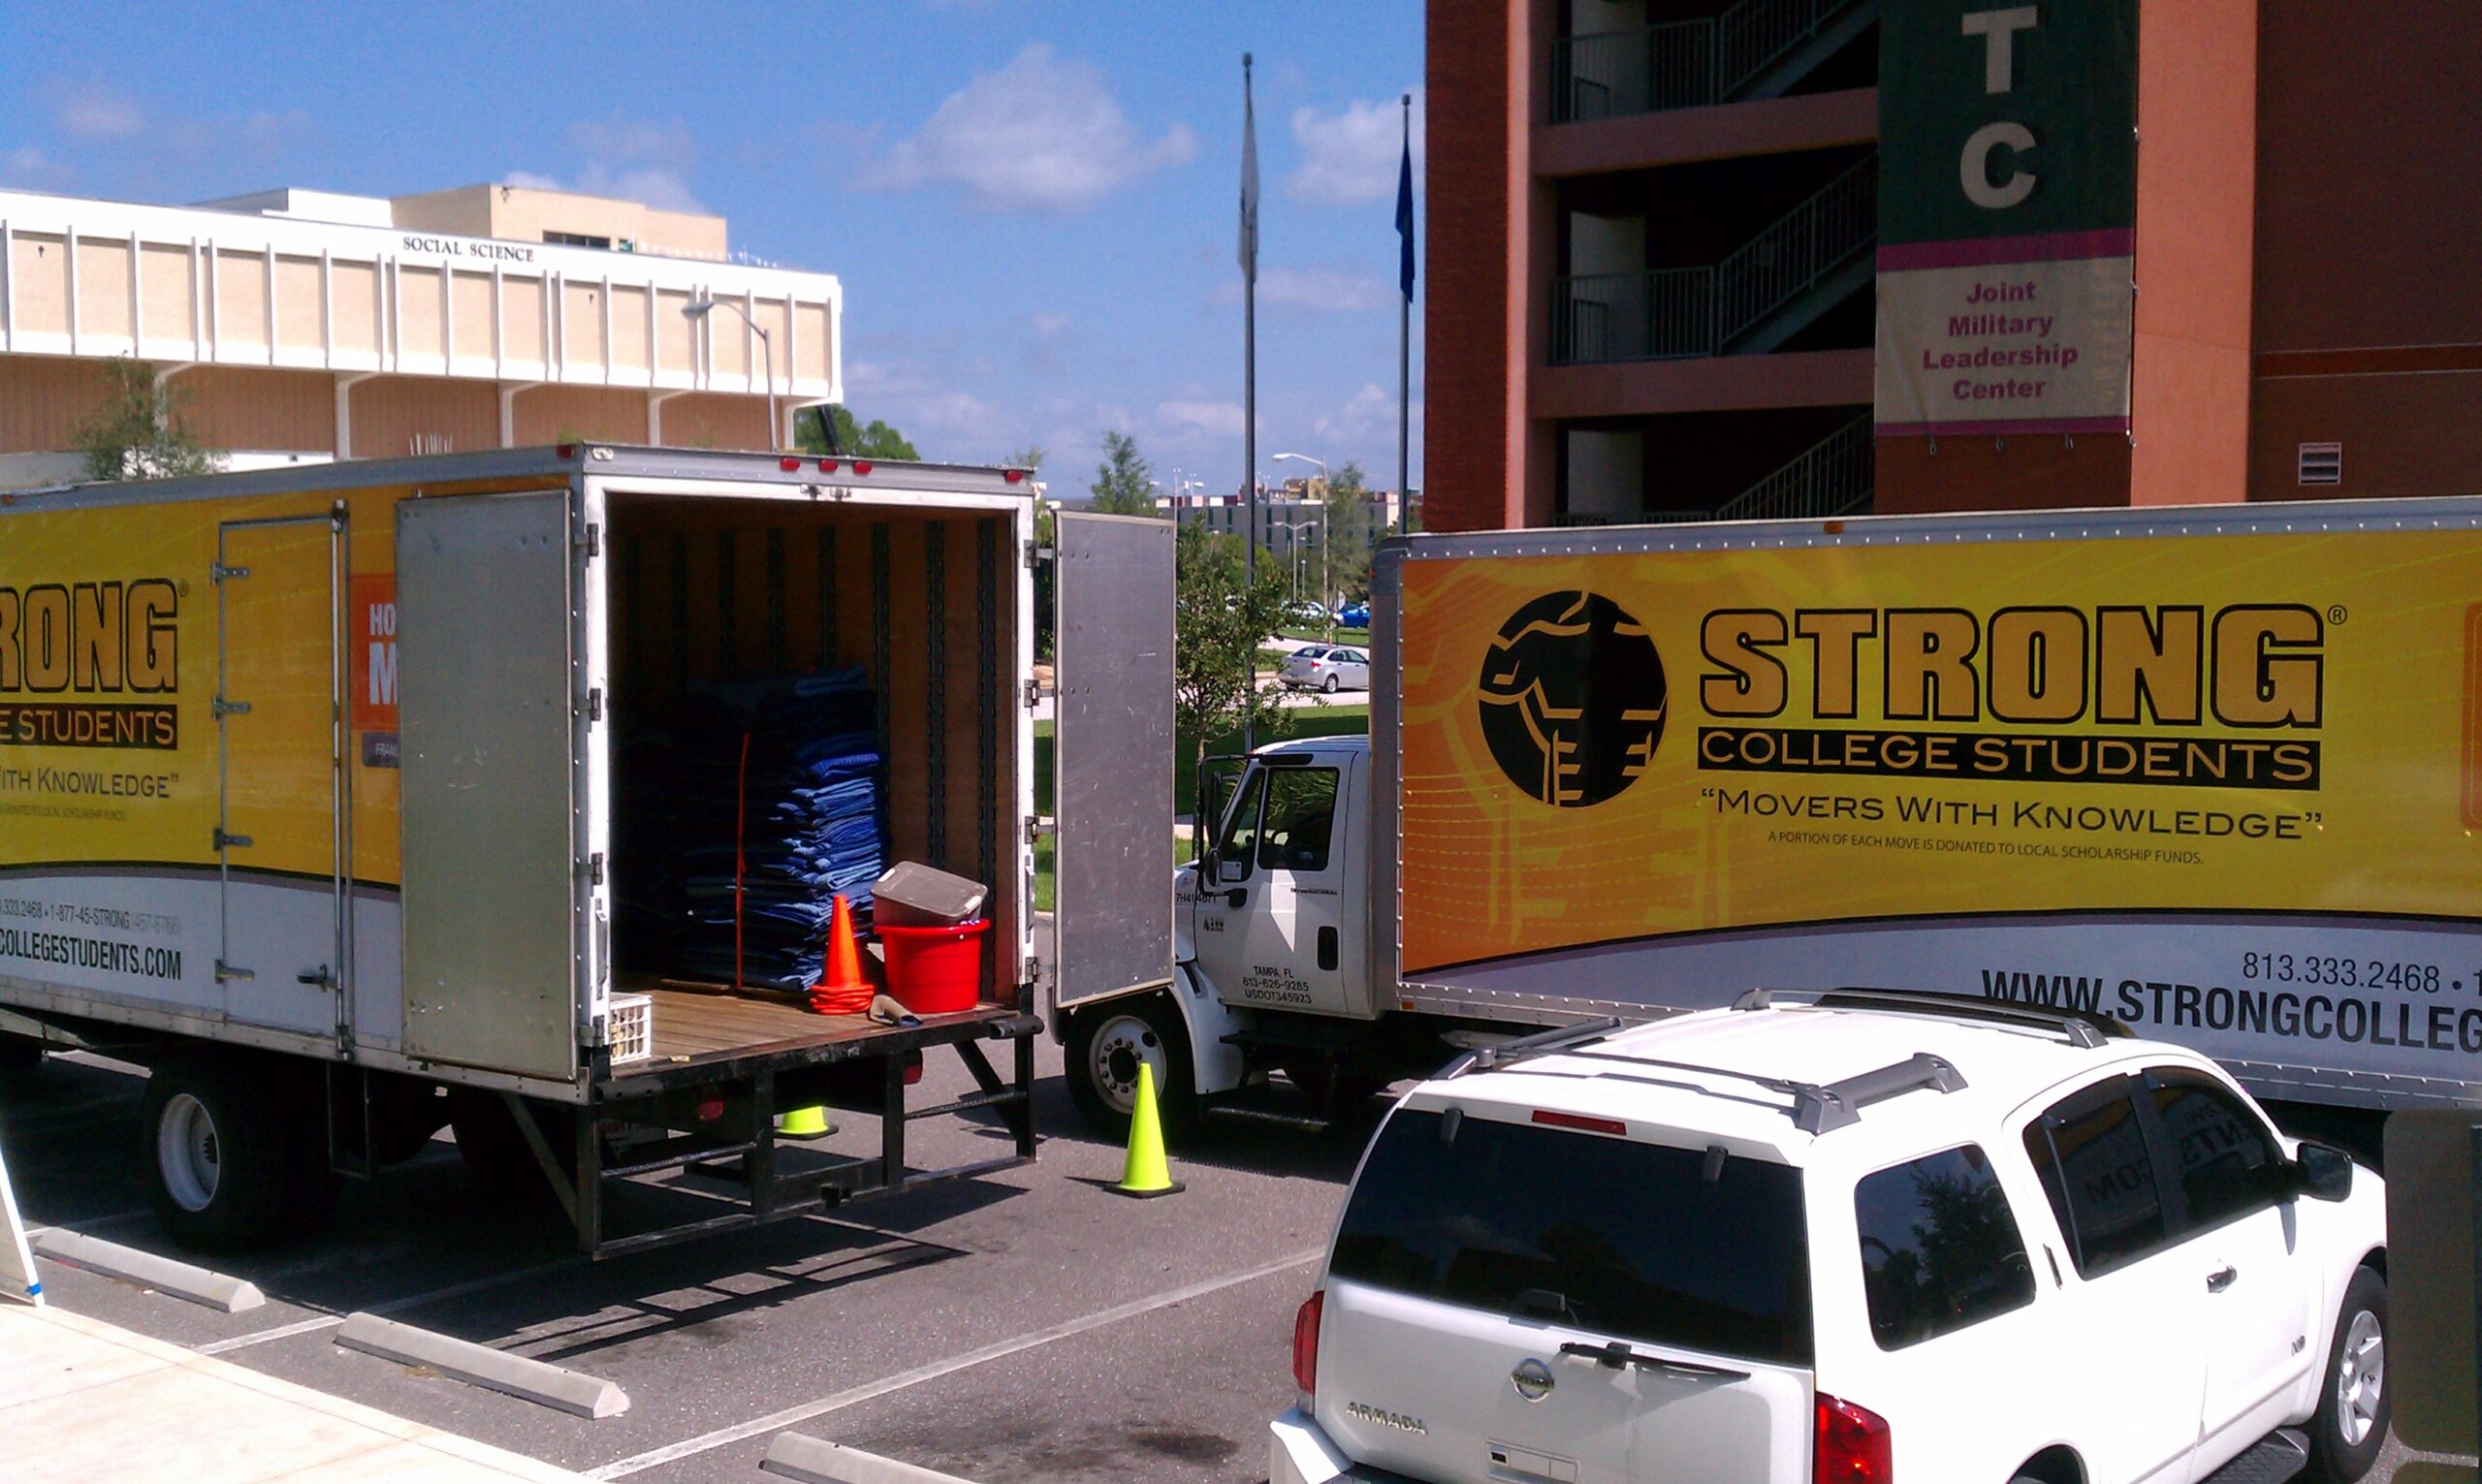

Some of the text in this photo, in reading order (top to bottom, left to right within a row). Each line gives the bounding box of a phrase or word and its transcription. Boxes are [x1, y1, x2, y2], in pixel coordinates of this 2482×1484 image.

[403, 237, 534, 262] SOCIAL SCIENCE
[1966, 280, 2036, 304] Joint
[1949, 315, 2053, 337] Military
[1923, 343, 2079, 369] Leadership
[1953, 378, 2047, 400] Center
[18, 710, 175, 745] STUDENTS
[1702, 730, 2313, 782] COLLEGE STUDENTS
[1768, 831, 1776, 842] A
[1779, 831, 1830, 844] PORTION
[1832, 833, 1849, 845] OF
[1851, 835, 1883, 848] EACH
[1885, 837, 1921, 849] MOVE
[1923, 838, 1933, 850] IS
[1935, 838, 1996, 854] DONATED
[1998, 842, 2016, 855] TO
[2018, 843, 2059, 858] LOCAL
[2062, 846, 2152, 862] SCHOLARSHIP
[1242, 976, 1310, 992] 813-626-9285
[1284, 968, 1294, 979] FL
[2242, 951, 2440, 994] 813.333.2468
[1245, 989, 1312, 1004] USDOT345923
[1346, 1401, 1429, 1437] ARMADA
